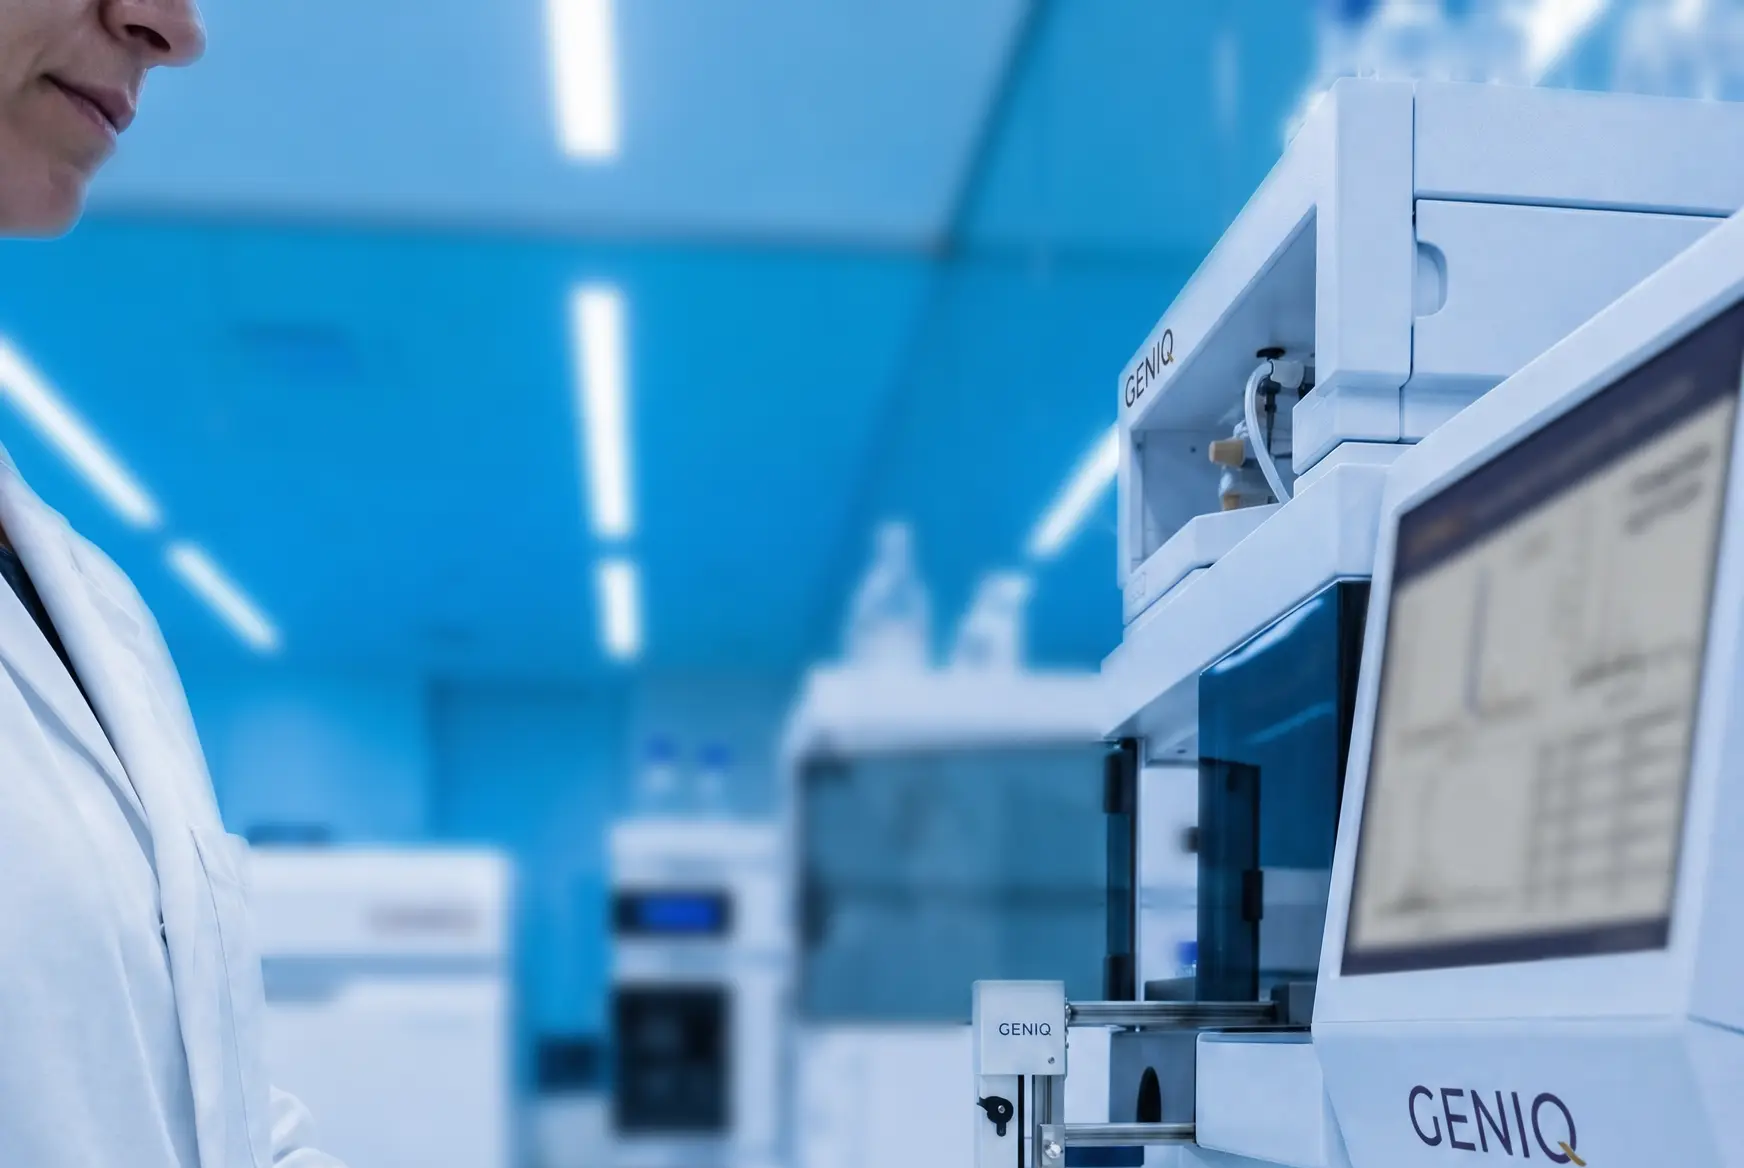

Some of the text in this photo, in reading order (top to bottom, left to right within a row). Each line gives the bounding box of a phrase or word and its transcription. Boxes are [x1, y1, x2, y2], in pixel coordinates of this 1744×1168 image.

[1125, 328, 1174, 408] GENIQ
[998, 1022, 1052, 1036] GENIQ
[1408, 1085, 1587, 1167] GENIQ
